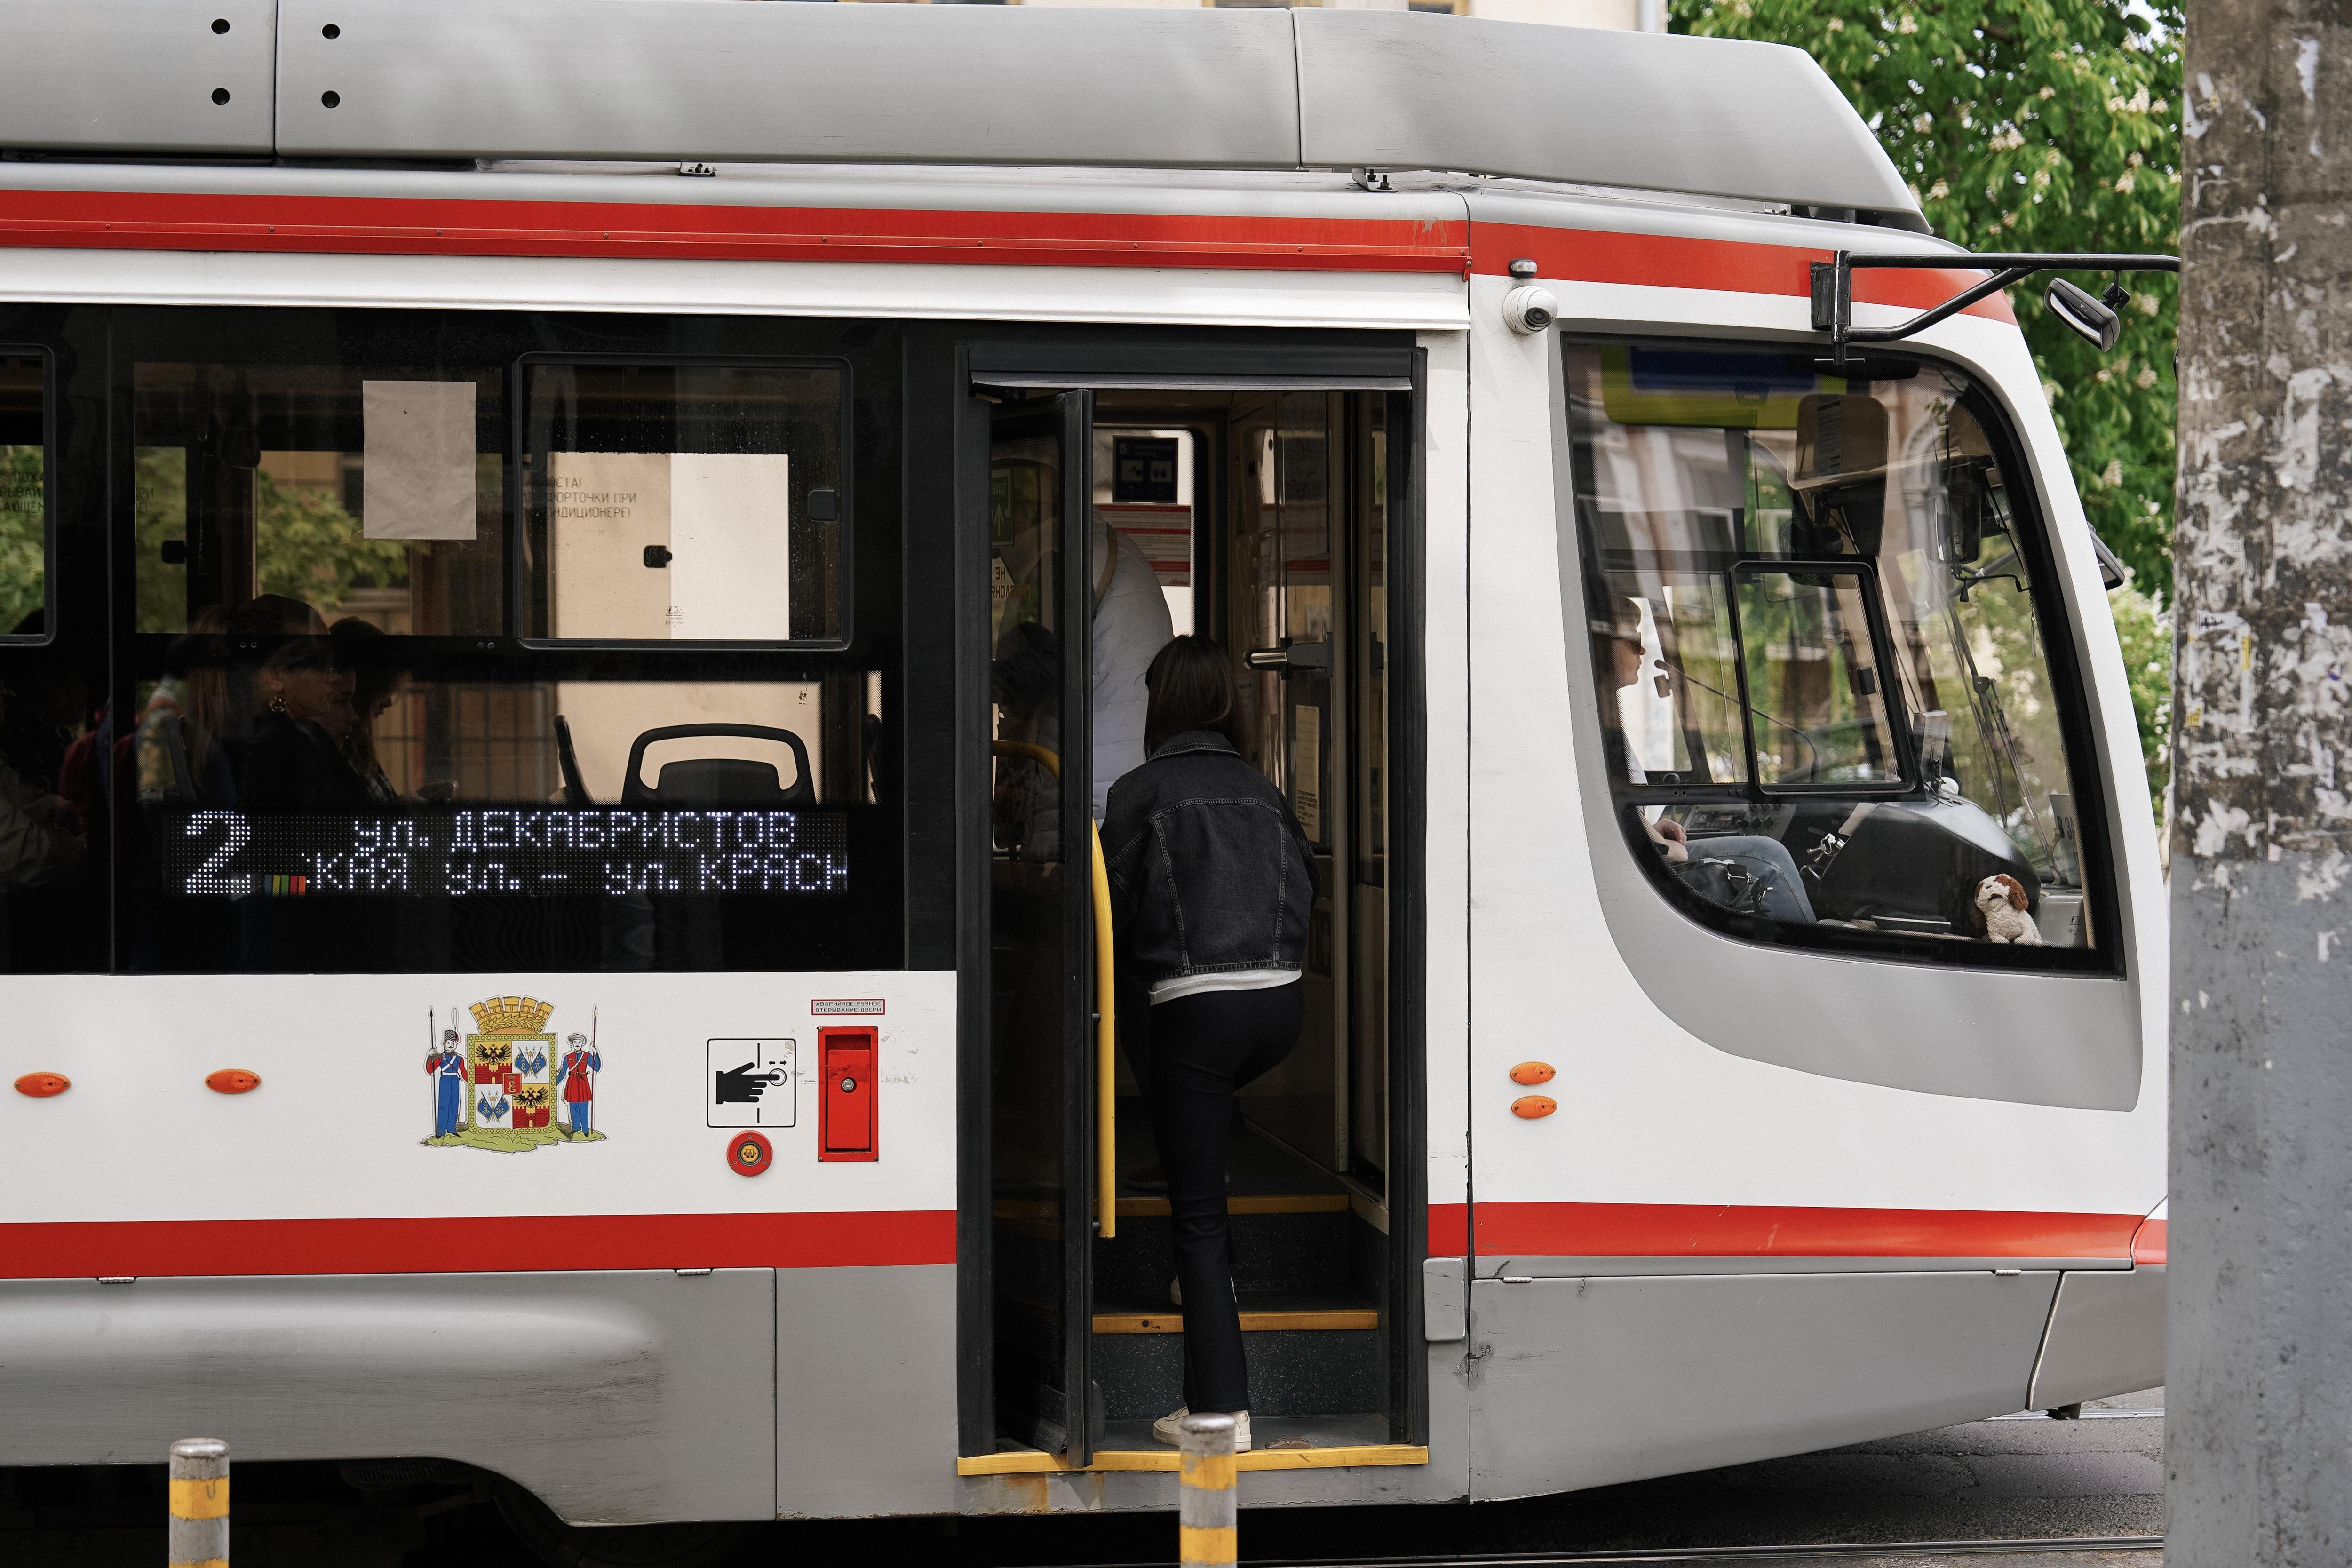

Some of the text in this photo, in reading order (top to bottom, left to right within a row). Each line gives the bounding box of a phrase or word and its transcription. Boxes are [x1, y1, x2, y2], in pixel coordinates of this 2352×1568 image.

[614, 492, 637, 503] ПРИ
[187, 810, 251, 894] 2
[355, 811, 795, 857] ул. ДЕКАБРИСТОВ
[445, 864, 521, 895] ул.
[605, 864, 679, 895] ул.
